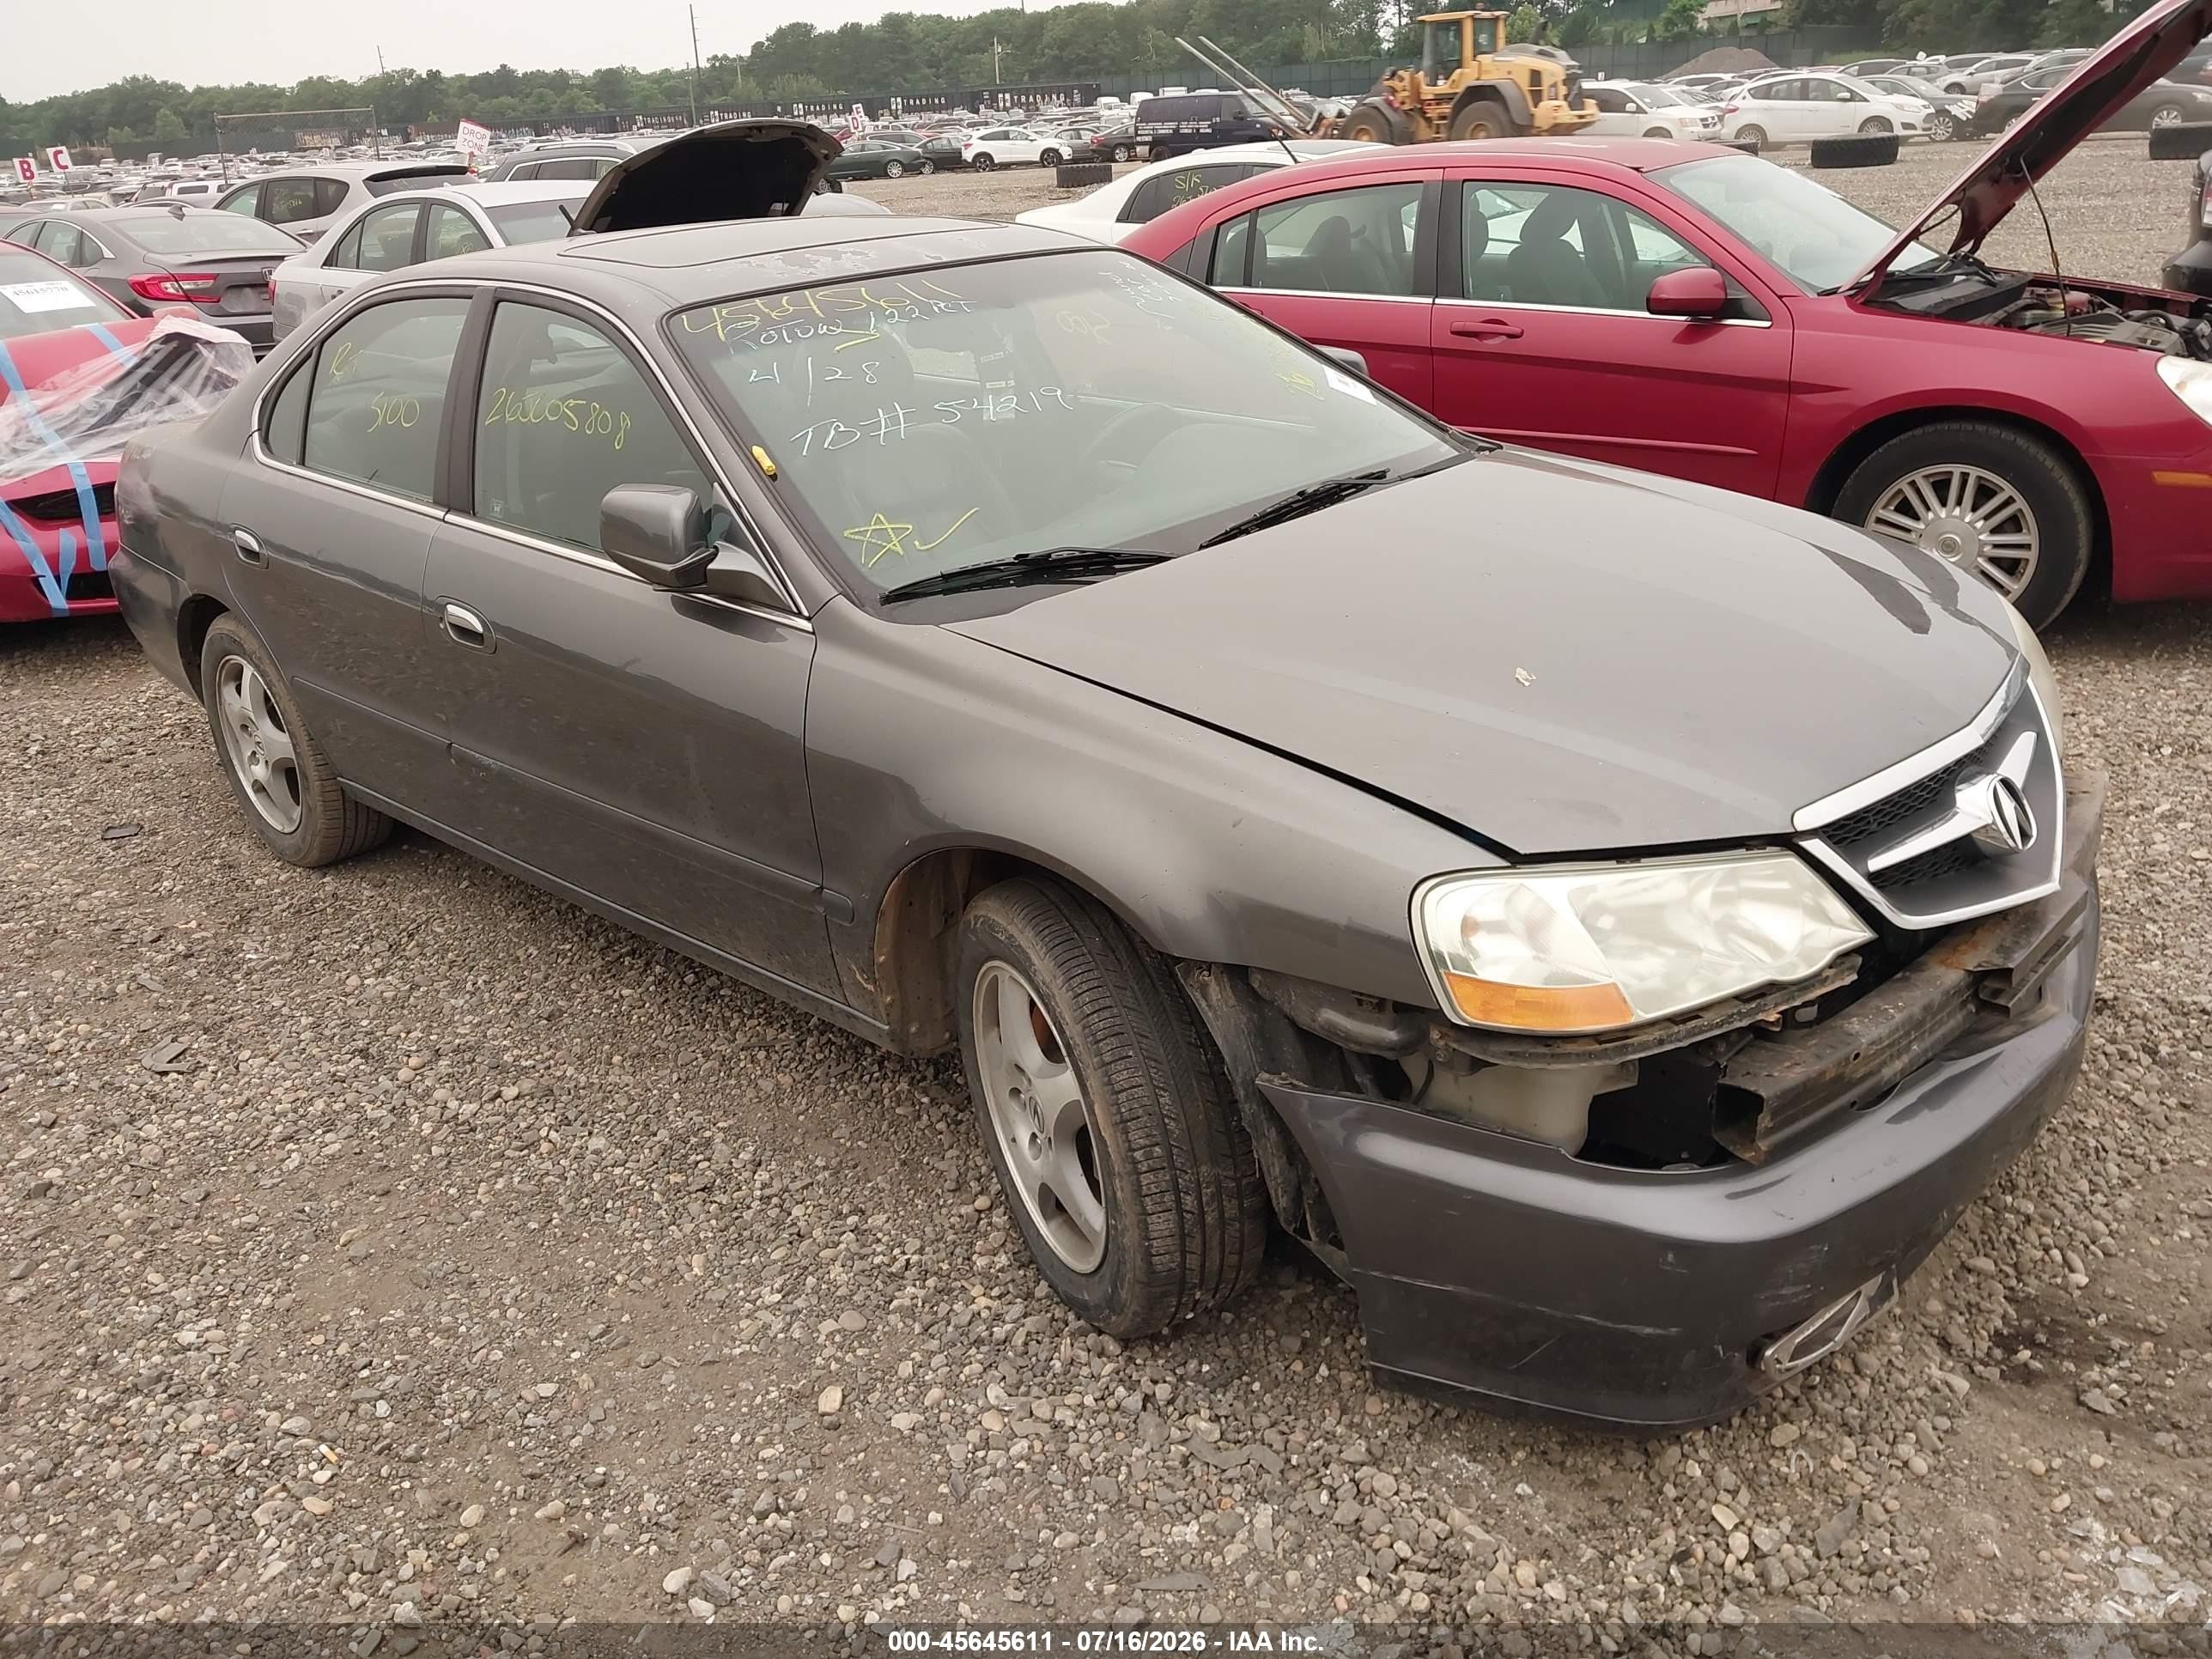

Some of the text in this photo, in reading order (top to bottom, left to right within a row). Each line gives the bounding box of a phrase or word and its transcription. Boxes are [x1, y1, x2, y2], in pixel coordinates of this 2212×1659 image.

[903, 96, 945, 106] TRADING
[1013, 93, 1065, 104] TRADING
[805, 102, 843, 112] TRADING
[720, 111, 751, 120] TRADING
[851, 116, 860, 131] D
[462, 126, 487, 142] DROP
[461, 137, 485, 154] ZONE
[52, 149, 70, 170] C
[19, 160, 35, 181] B
[934, 386, 1073, 423] 54219
